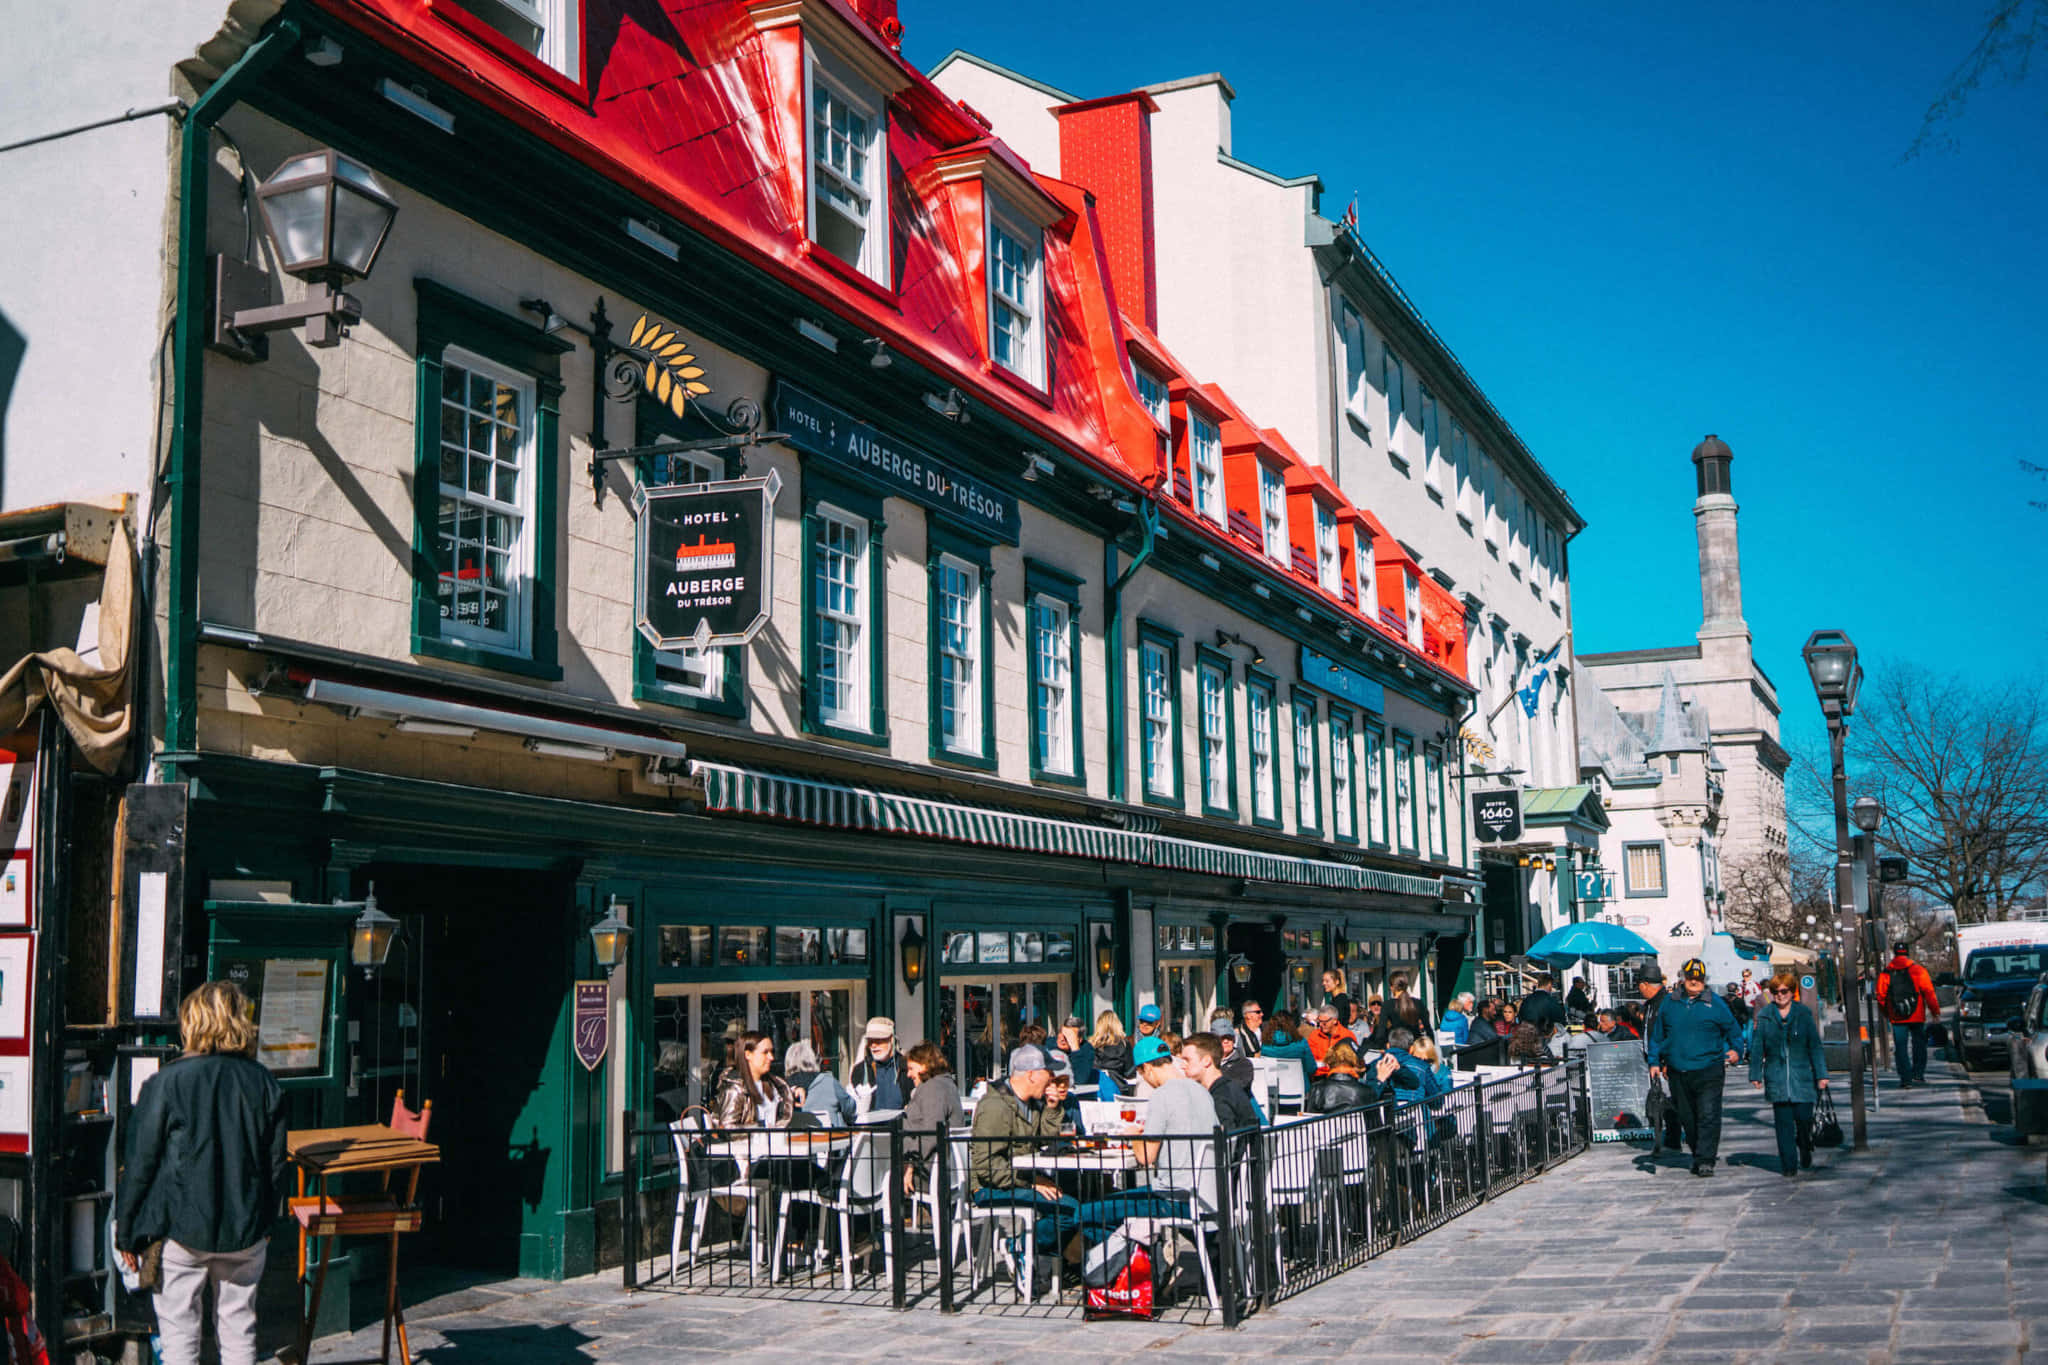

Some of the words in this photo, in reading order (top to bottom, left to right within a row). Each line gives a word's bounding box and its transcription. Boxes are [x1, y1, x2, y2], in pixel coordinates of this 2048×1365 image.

[789, 407, 822, 433] HOTEL
[848, 432, 922, 487] AUBERGE
[927, 470, 946, 497] DU
[950, 481, 1004, 523] TRÉSOR
[684, 512, 729, 526] HOTEL
[665, 576, 745, 597] AUBERGE
[677, 599, 692, 608] DU
[694, 594, 732, 607] TRÉSOR
[1480, 807, 1514, 820] 1640
[1593, 1130, 1655, 1143] Heineken
